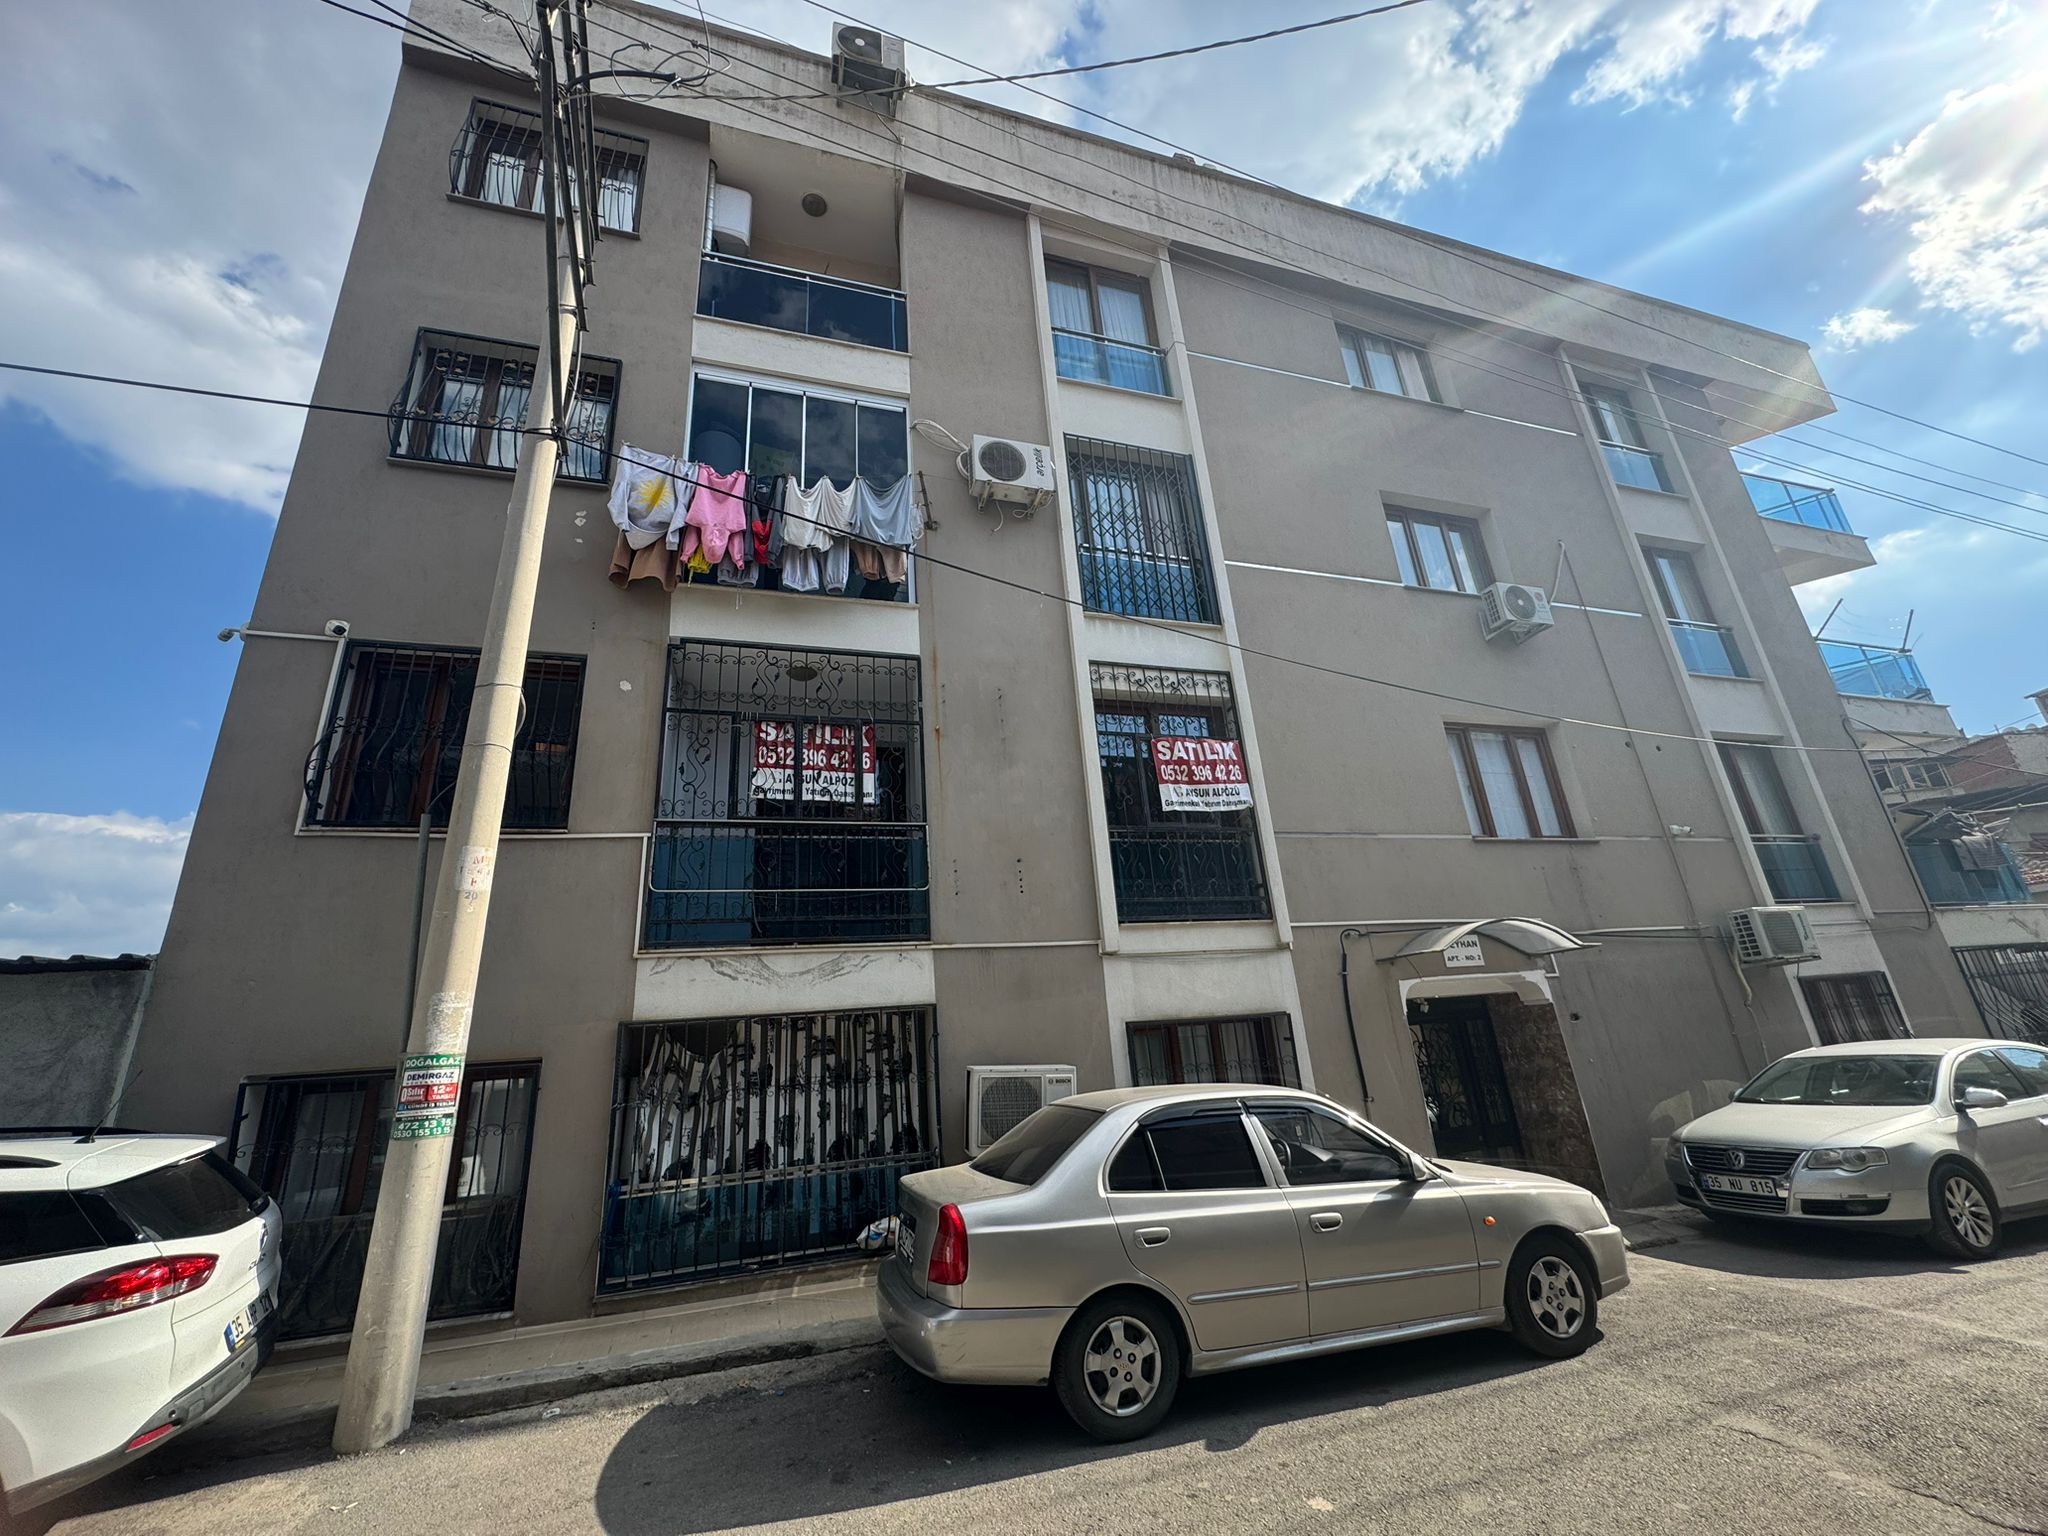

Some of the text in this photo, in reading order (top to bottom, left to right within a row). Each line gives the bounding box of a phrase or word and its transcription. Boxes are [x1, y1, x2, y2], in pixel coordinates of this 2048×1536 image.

[1032, 447, 1045, 476] arçelik
[758, 745, 795, 766] 0532
[802, 749, 826, 768] 396
[1156, 740, 1238, 761] SATILIK
[1160, 764, 1242, 782] 0532 396 42 26
[1185, 785, 1240, 798] AYSUN ALPÖZÜ
[406, 1056, 461, 1068] DOĞALGAZ
[406, 1071, 454, 1082] DEMİRGAZ
[432, 1085, 446, 1094] 12
[398, 1122, 420, 1130] 472
[424, 1120, 437, 1128] 13
[415, 1128, 430, 1137] 155
[1708, 1176, 1773, 1194] 35 NU 815
[231, 1315, 244, 1338] 35
